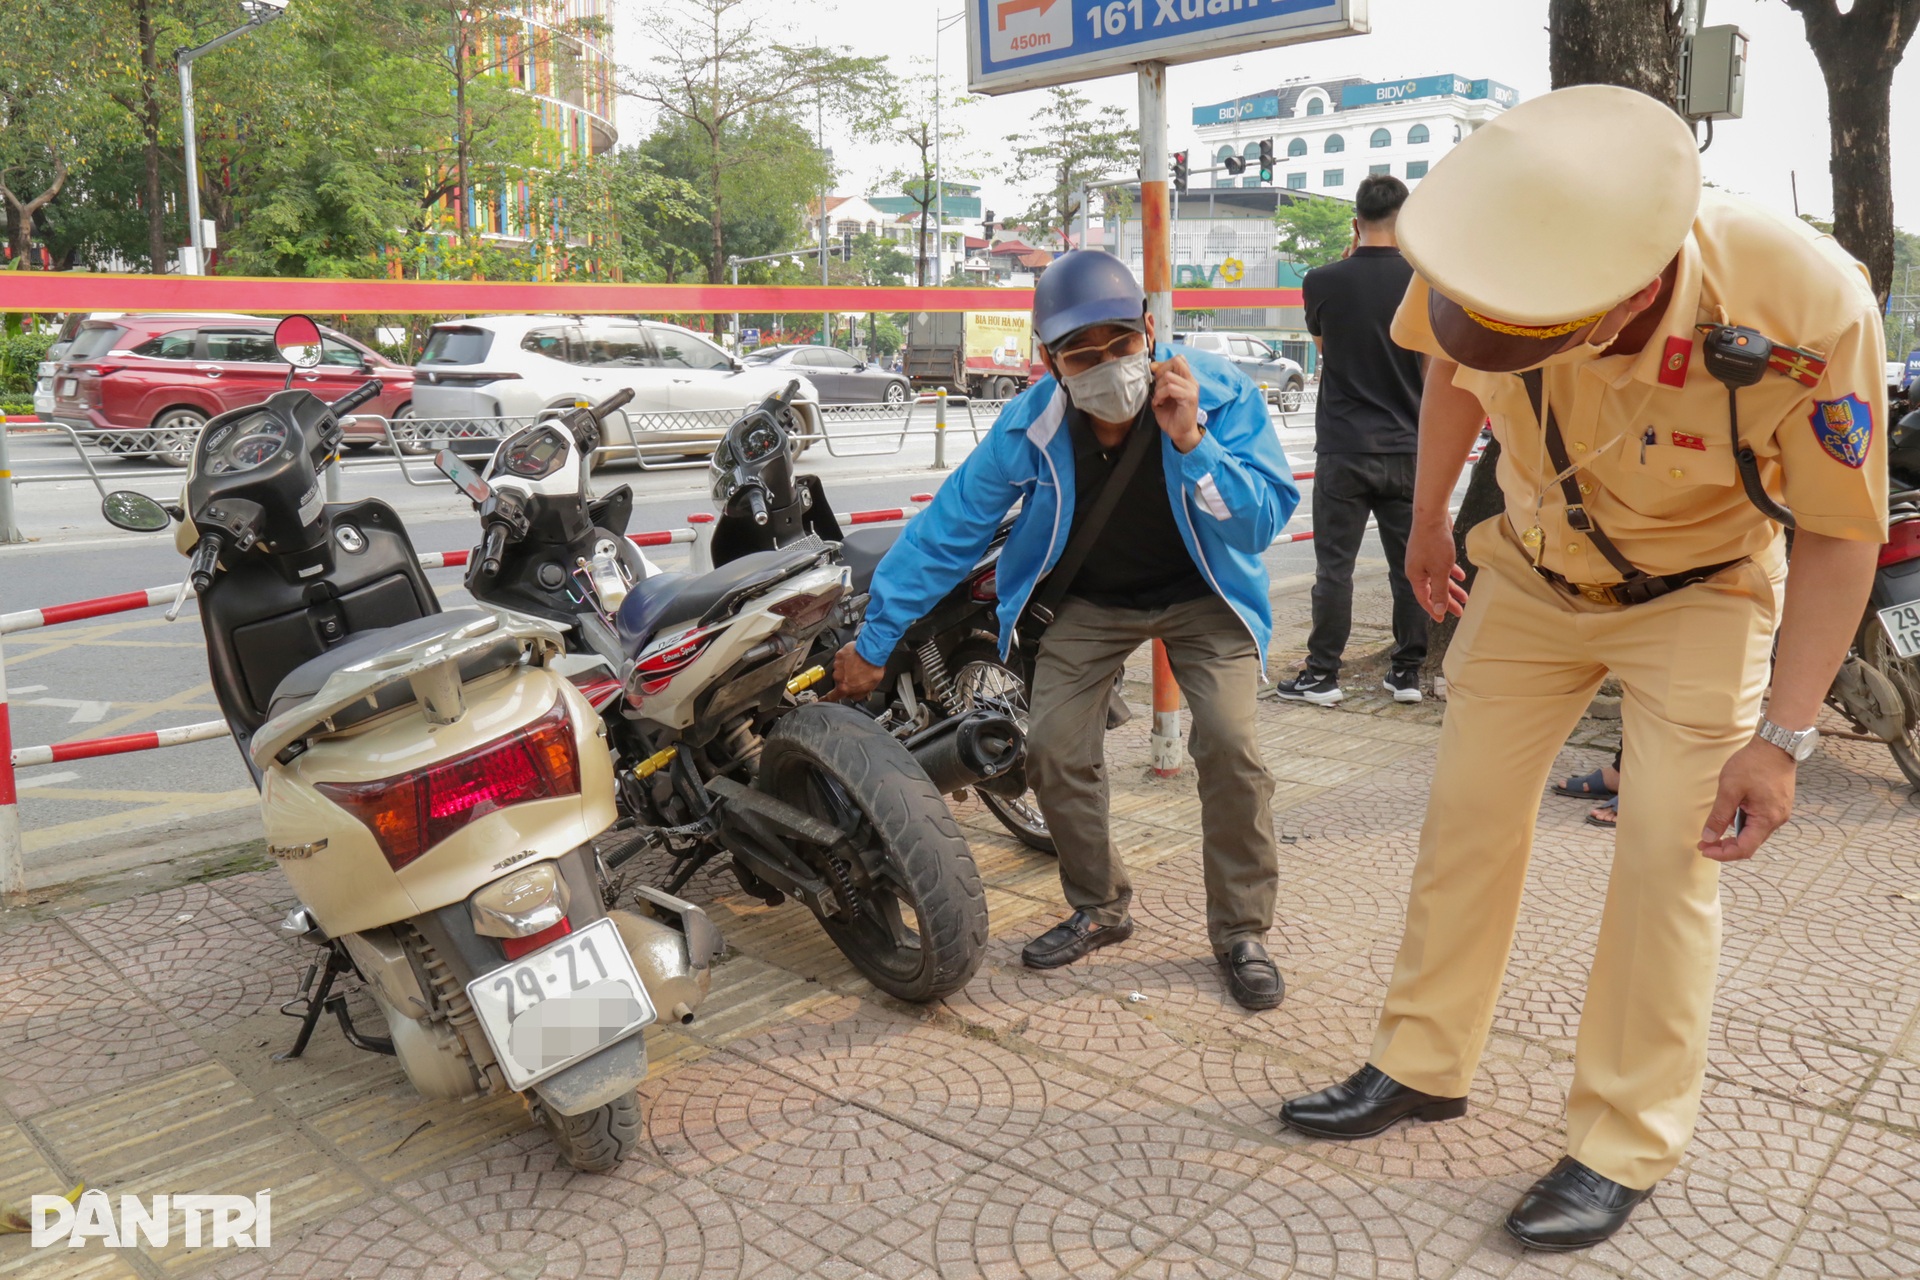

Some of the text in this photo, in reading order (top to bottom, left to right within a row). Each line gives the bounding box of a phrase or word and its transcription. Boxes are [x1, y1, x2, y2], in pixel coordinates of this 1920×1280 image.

[1086, 1, 1144, 39] 161
[1010, 33, 1051, 51] 450m
[1376, 84, 1407, 101] BIDV
[1218, 106, 1244, 120] BIDV
[975, 314, 987, 324] BIA
[1891, 607, 1920, 630] 29
